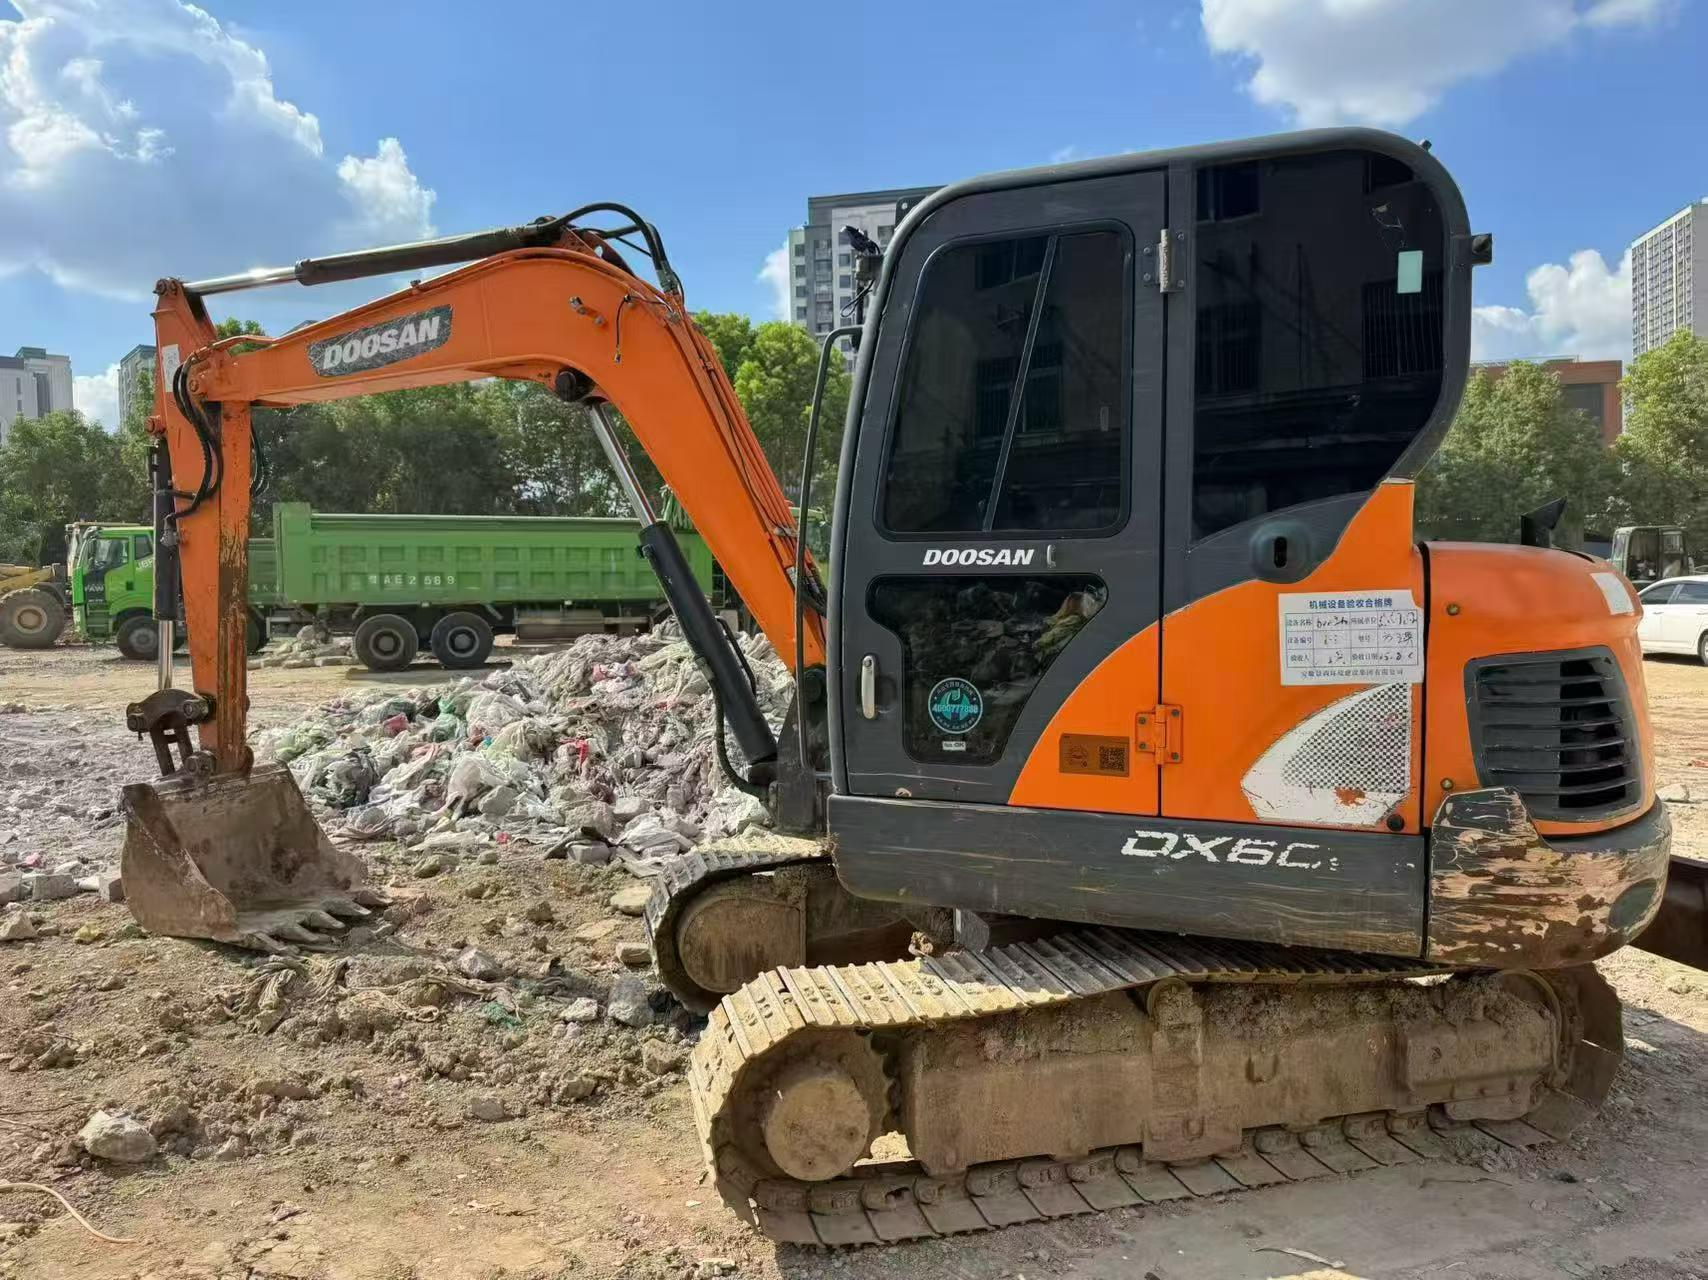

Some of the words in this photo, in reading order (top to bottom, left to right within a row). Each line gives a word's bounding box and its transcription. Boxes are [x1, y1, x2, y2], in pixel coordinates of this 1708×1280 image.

[323, 316, 440, 369] DOOSAN
[922, 549, 1035, 566] DOOSAN
[1309, 598, 1393, 609] 机械设备验收合格牌
